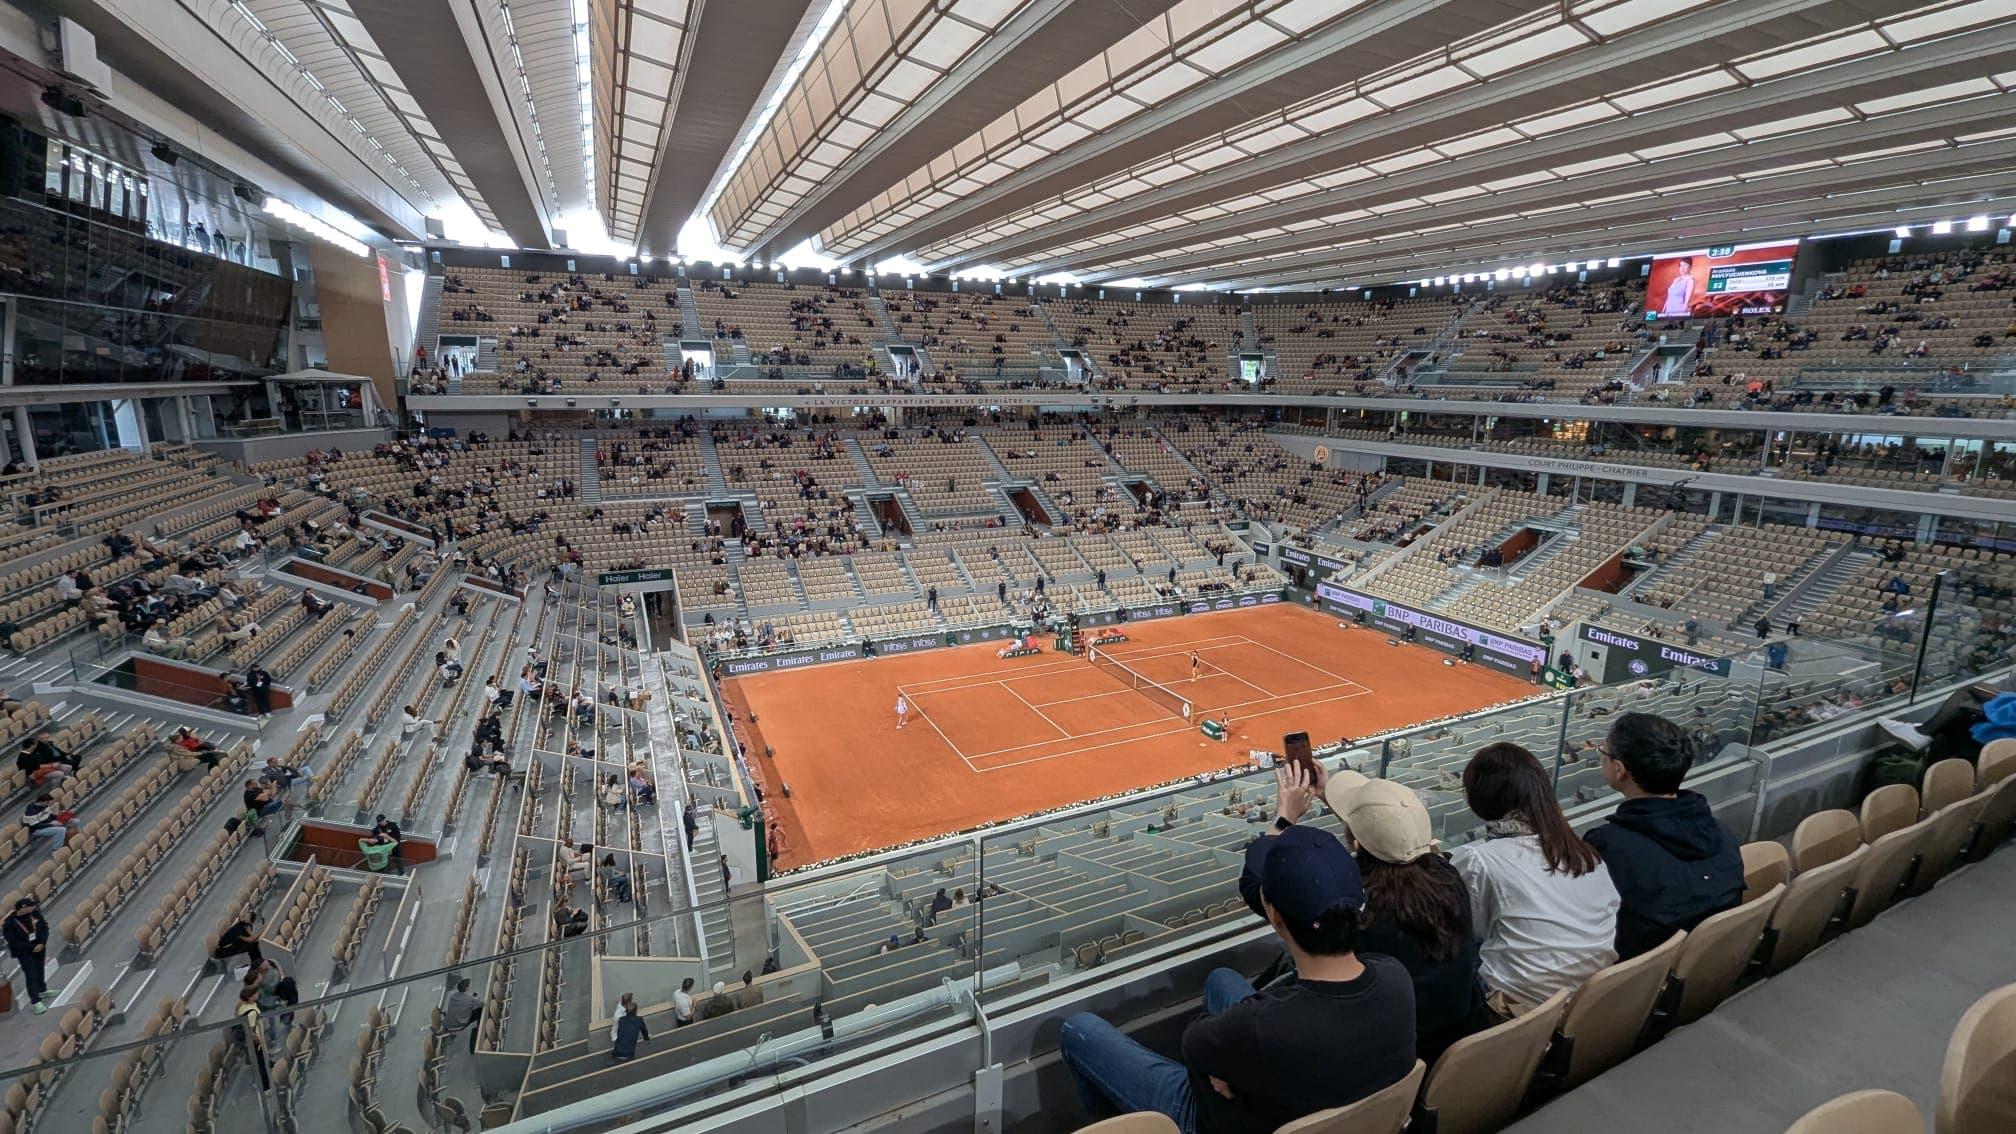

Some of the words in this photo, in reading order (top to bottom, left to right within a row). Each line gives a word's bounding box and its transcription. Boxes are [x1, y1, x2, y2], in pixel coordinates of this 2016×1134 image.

[1528, 459, 1556, 468] COURT
[1285, 548, 1310, 562] Emirates
[1317, 557, 1345, 570] Emirates
[605, 574, 629, 583] Haier
[638, 571, 662, 580] Haier
[1387, 606, 1409, 620] BNP
[1419, 616, 1468, 639] PARIBAS
[1588, 628, 1640, 650] Emirates
[729, 660, 769, 673] Emirates
[776, 654, 814, 667] Emirates
[820, 648, 857, 661] Emirates
